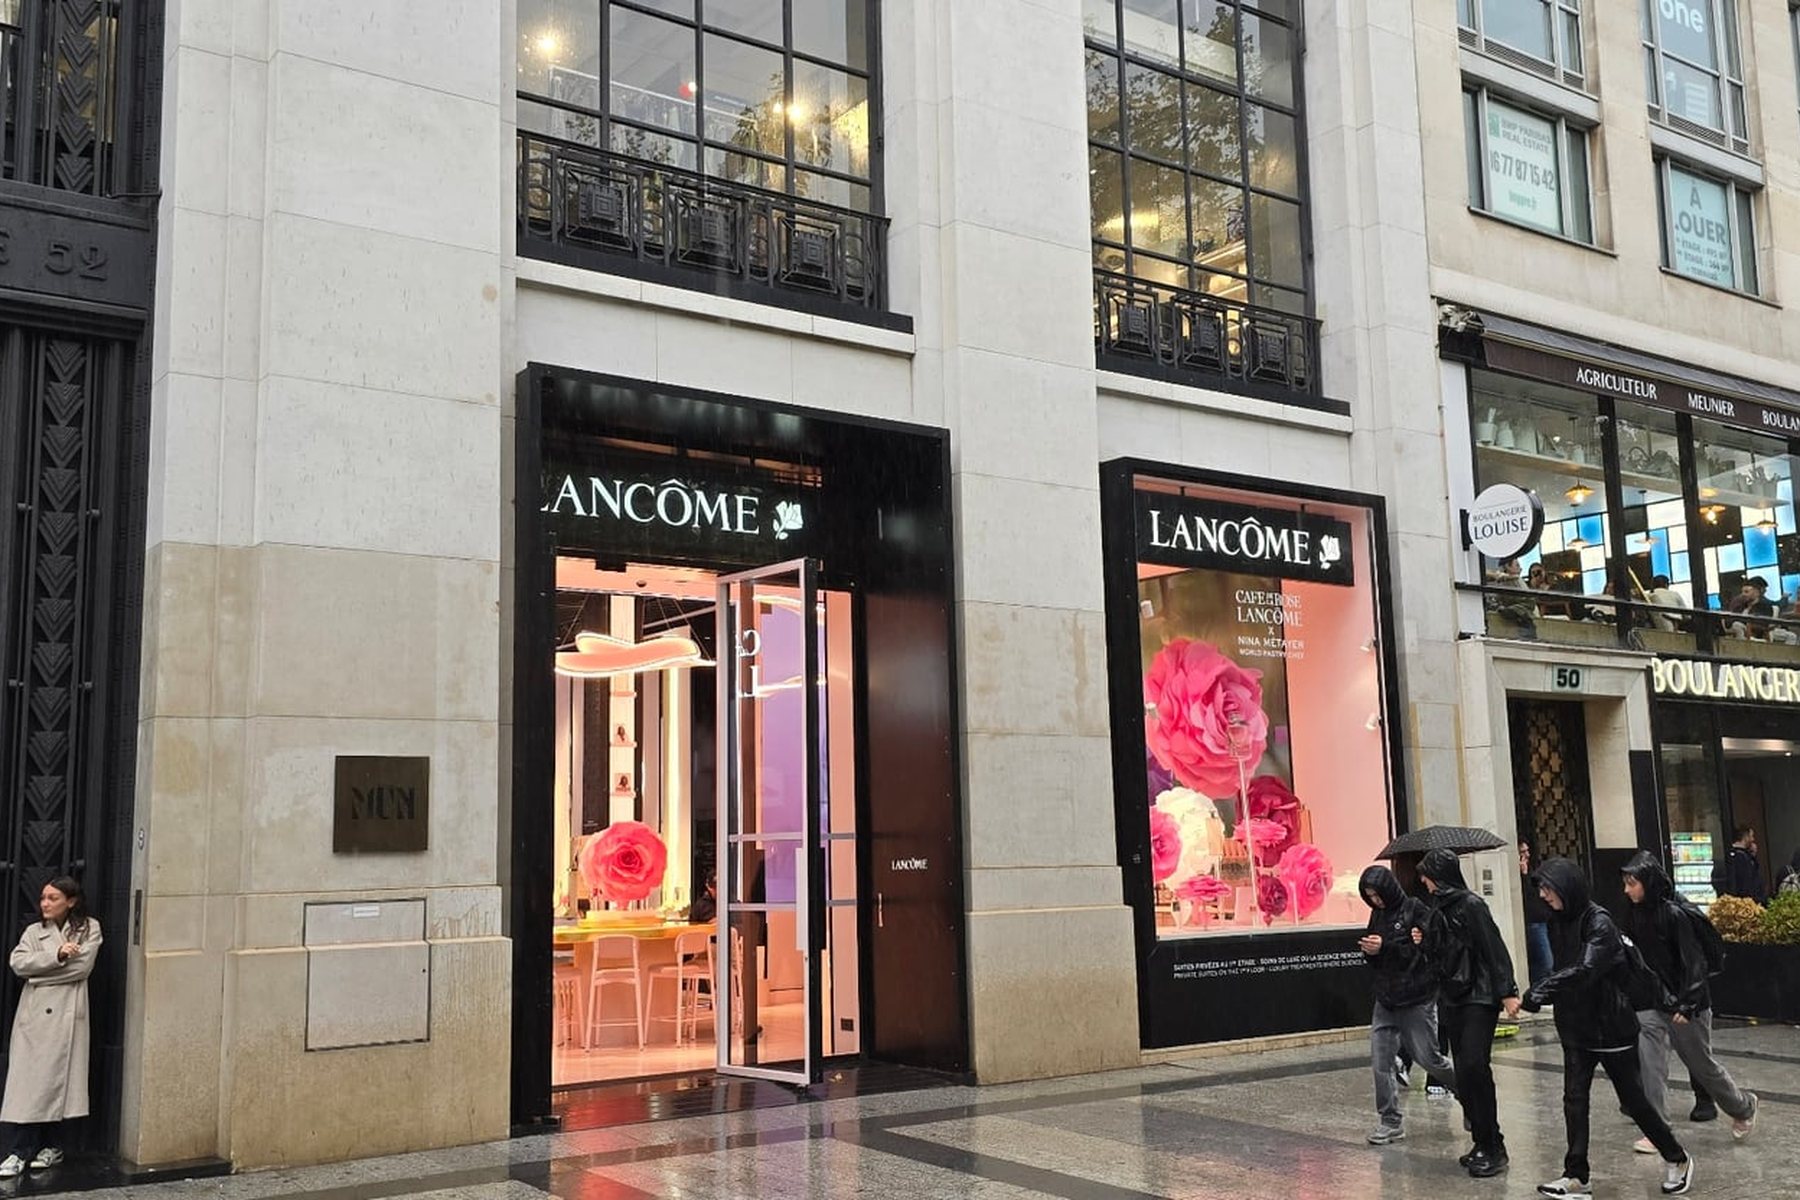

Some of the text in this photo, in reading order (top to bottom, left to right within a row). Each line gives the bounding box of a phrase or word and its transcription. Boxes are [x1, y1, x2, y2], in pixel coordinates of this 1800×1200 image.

[1675, 211, 1726, 245] OUER
[45, 242, 108, 282] 52
[1576, 366, 1658, 400] AGRICULTEUR
[1688, 392, 1735, 417] MEUNIER
[540, 474, 760, 535] ANCÔME
[1473, 504, 1527, 522] BOULANGERIE
[1149, 509, 1311, 565] LANCÔME
[1474, 516, 1529, 540] LOUISE
[1237, 606, 1303, 627] LANCÔME
[1238, 635, 1261, 647] NINA
[1556, 668, 1580, 688] 50
